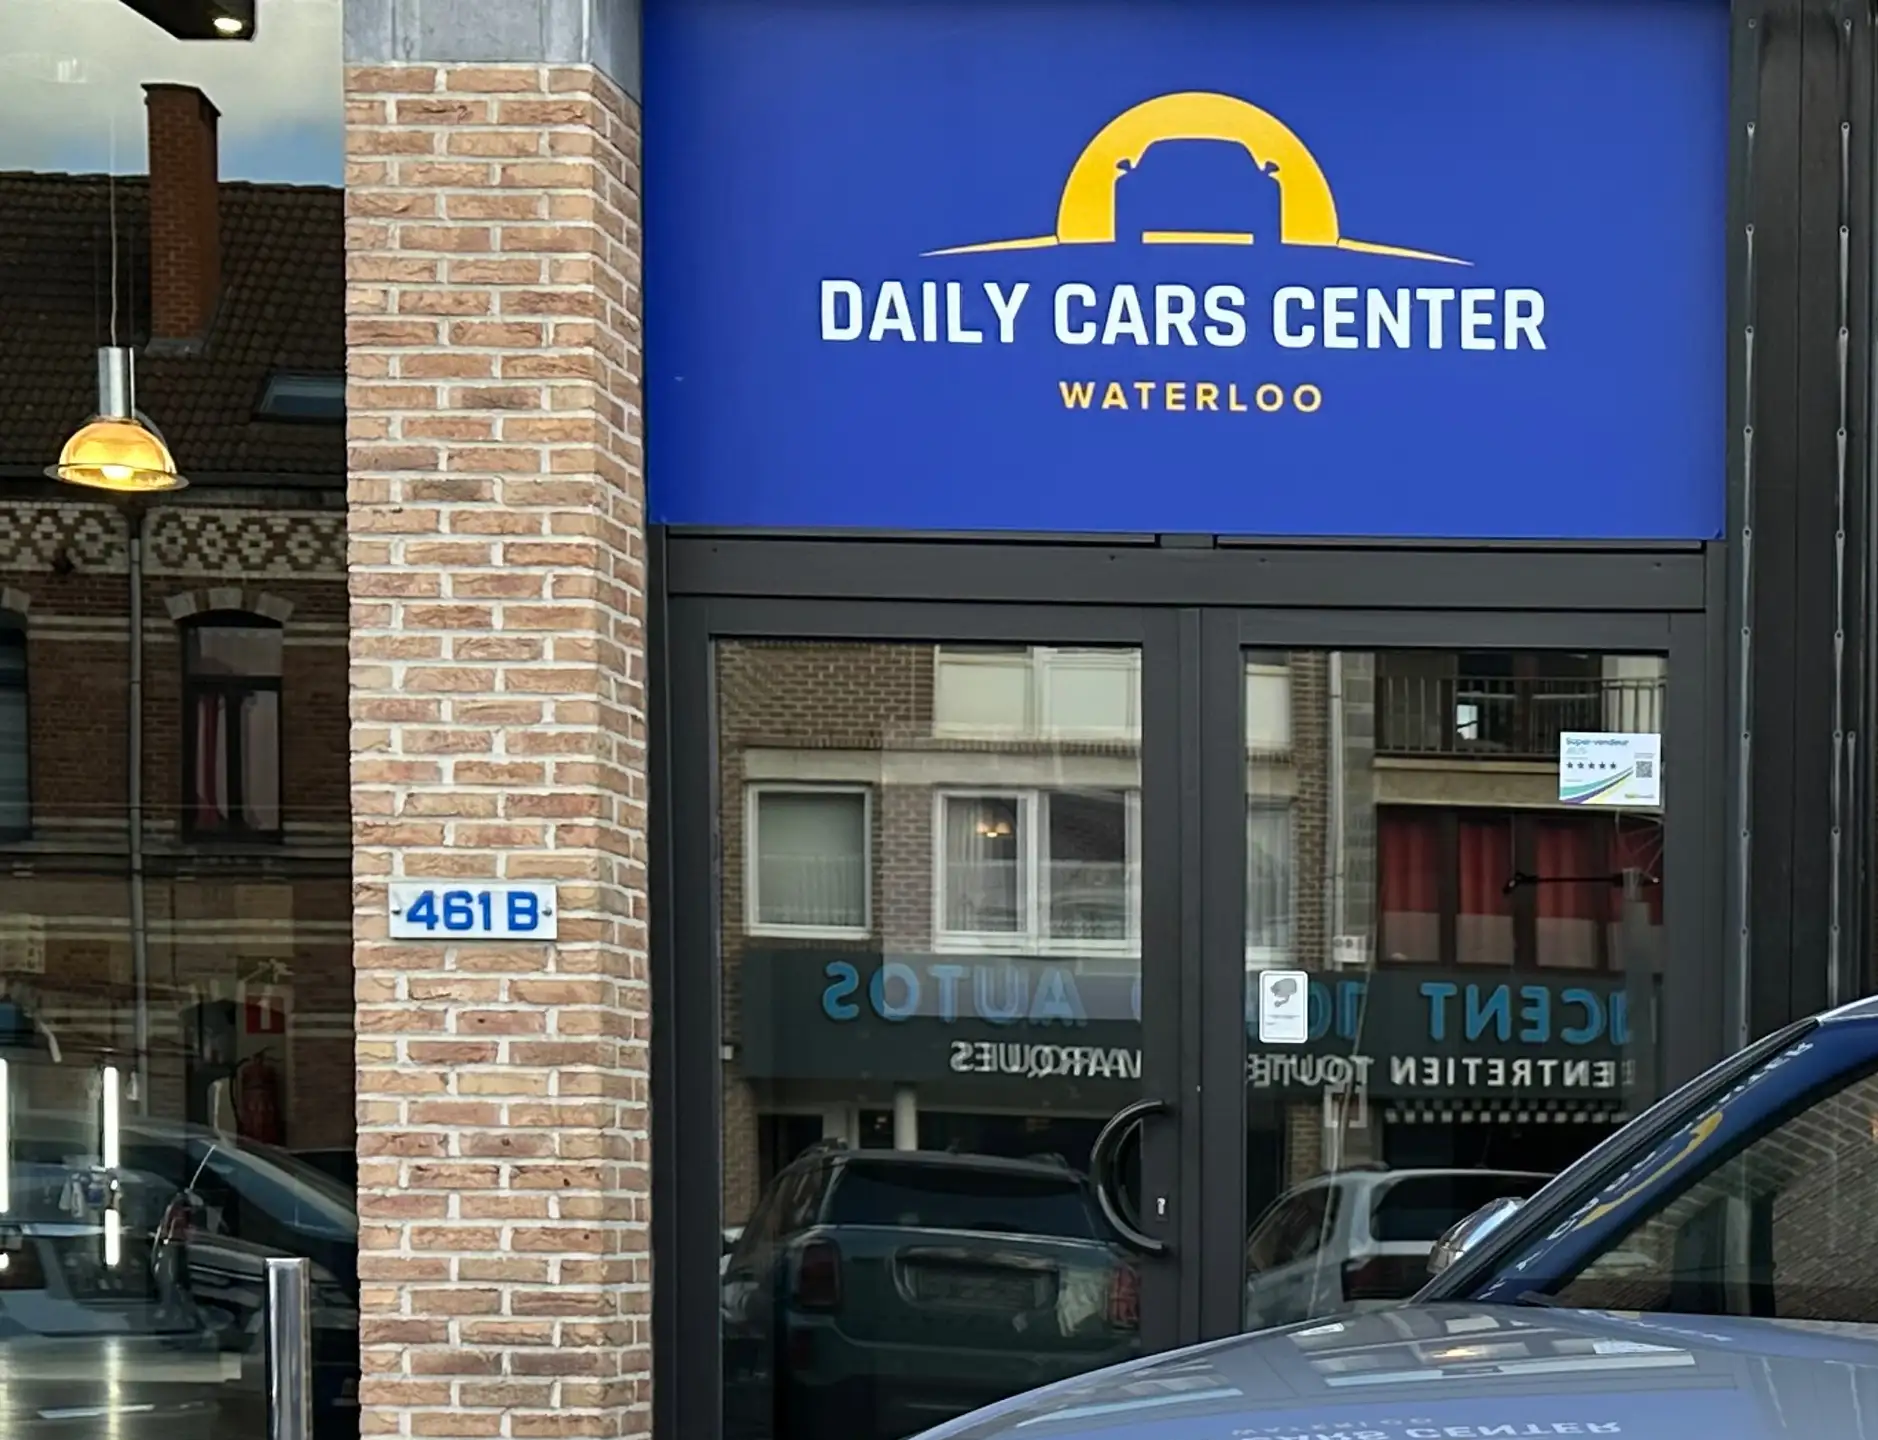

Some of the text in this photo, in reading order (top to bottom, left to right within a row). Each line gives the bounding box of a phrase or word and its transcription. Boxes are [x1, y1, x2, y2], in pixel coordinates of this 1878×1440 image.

[820, 280, 1547, 351] DAILY CARS CENTER
[1058, 381, 1323, 413] WATERLOO
[406, 890, 539, 932] 461 B
